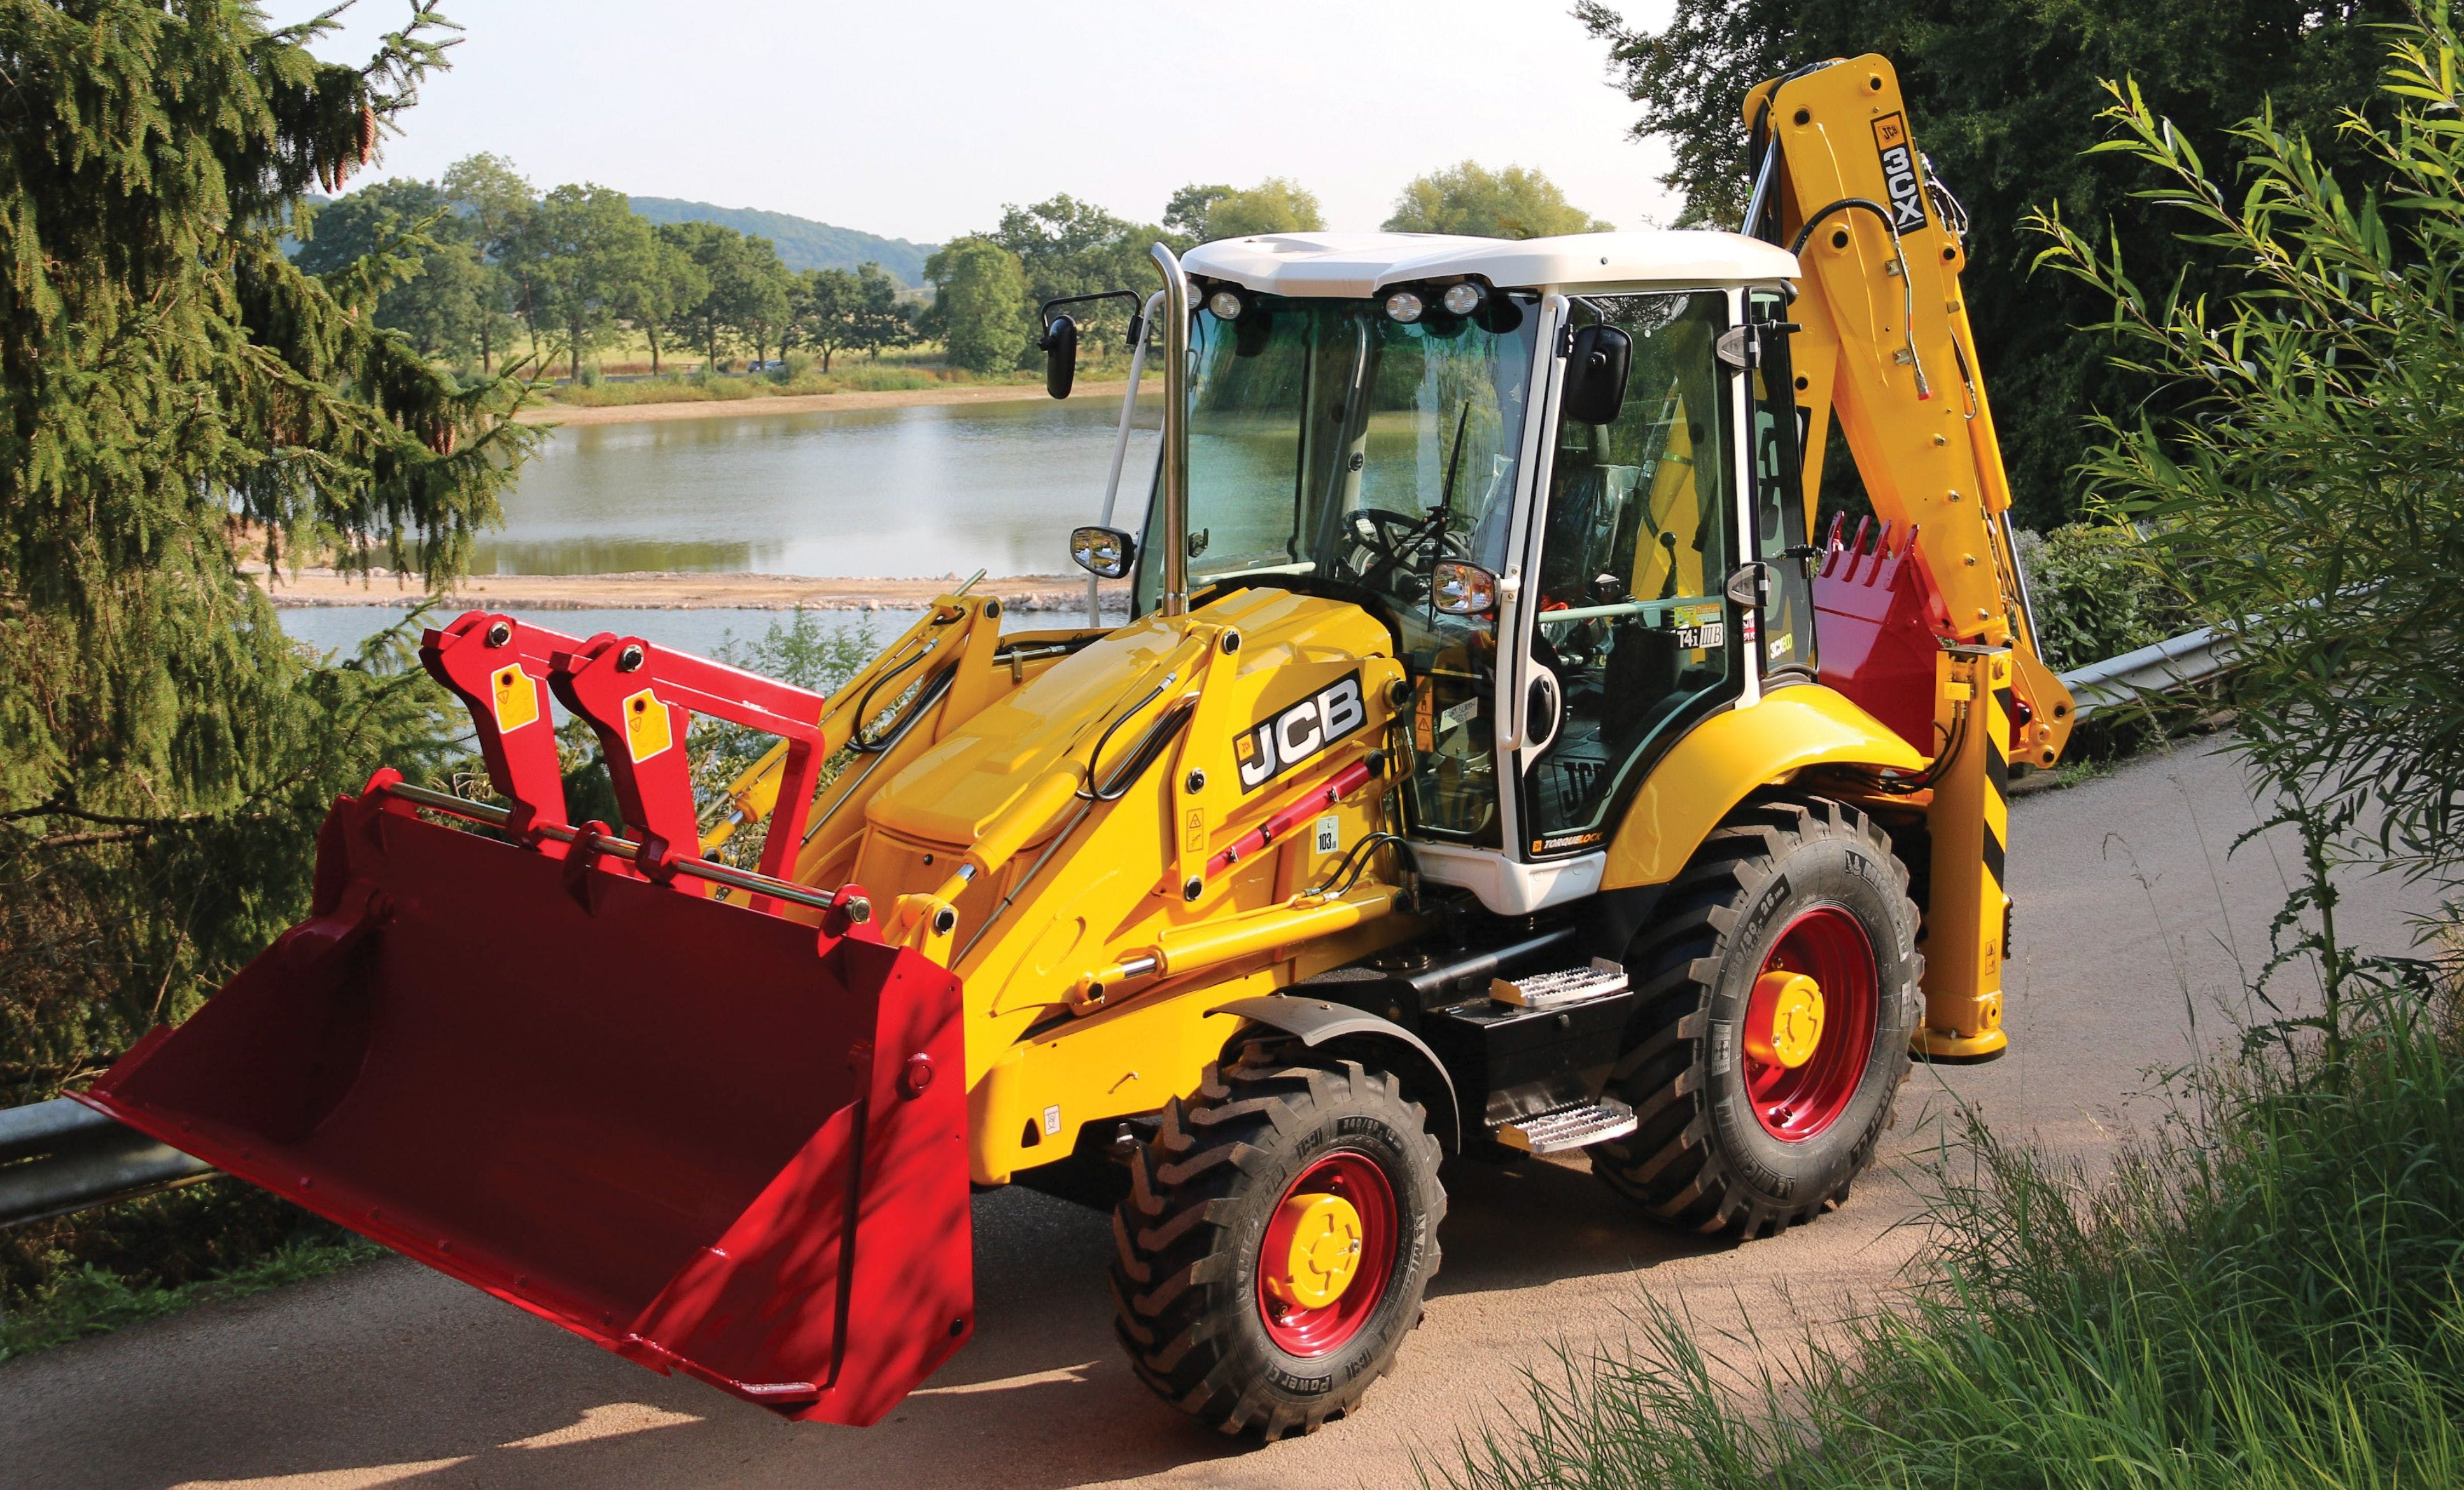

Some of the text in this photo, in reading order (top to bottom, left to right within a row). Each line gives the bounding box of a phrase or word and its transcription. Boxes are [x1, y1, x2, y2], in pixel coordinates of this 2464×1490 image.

[1882, 125, 1898, 140] JCB
[1882, 146, 1924, 226] 3CX
[1677, 626, 1721, 648] T4i IIIB
[1241, 678, 1362, 786] JCB
[1319, 832, 1331, 851] 103
[1544, 832, 1603, 849] TORQUELOCK
[1761, 893, 1775, 917] 26
[1281, 1375, 1330, 1393] Power
